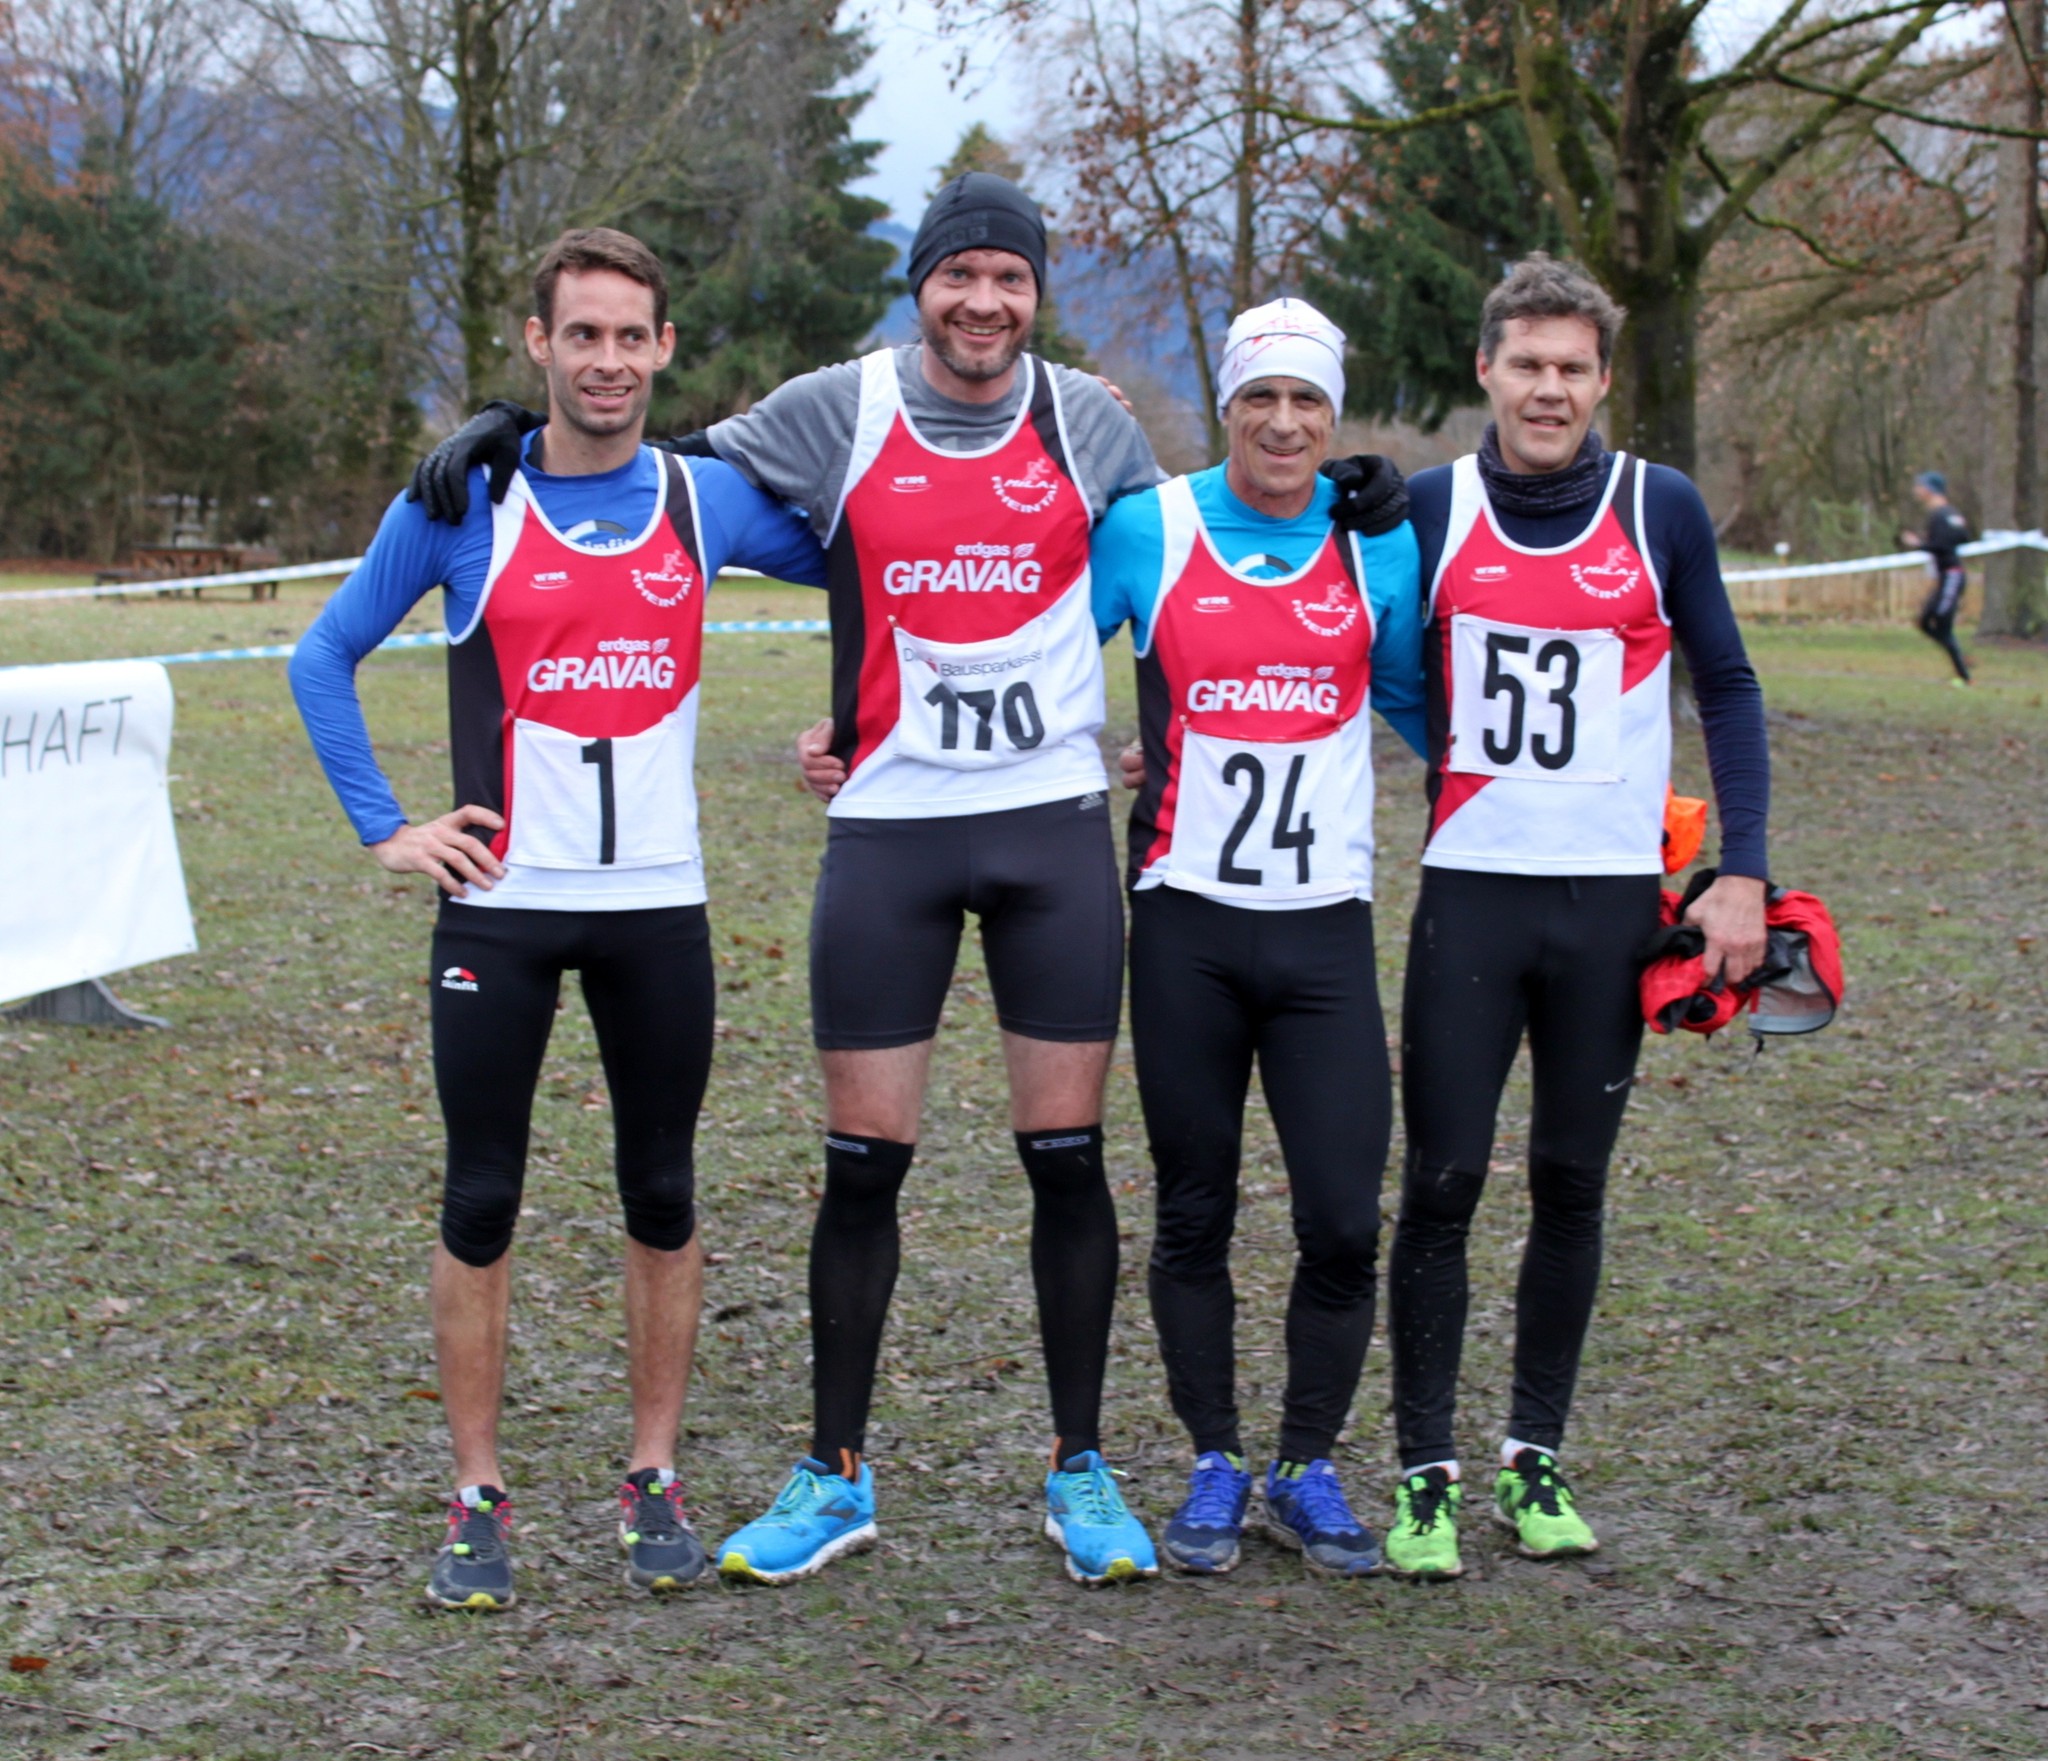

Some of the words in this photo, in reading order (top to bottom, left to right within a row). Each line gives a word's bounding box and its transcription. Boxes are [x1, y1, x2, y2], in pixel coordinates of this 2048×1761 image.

[954, 542, 1010, 558] erdgas
[883, 559, 1042, 595] GRAVAG
[597, 637, 650, 653] erdgas
[527, 656, 676, 692] GRAVAG
[1257, 663, 1311, 680] erdgas
[1187, 679, 1340, 714] GRAVAG
[1483, 632, 1580, 770] 53
[923, 681, 1045, 751] 170
[581, 738, 615, 864] 1
[1218, 752, 1315, 885] 24
